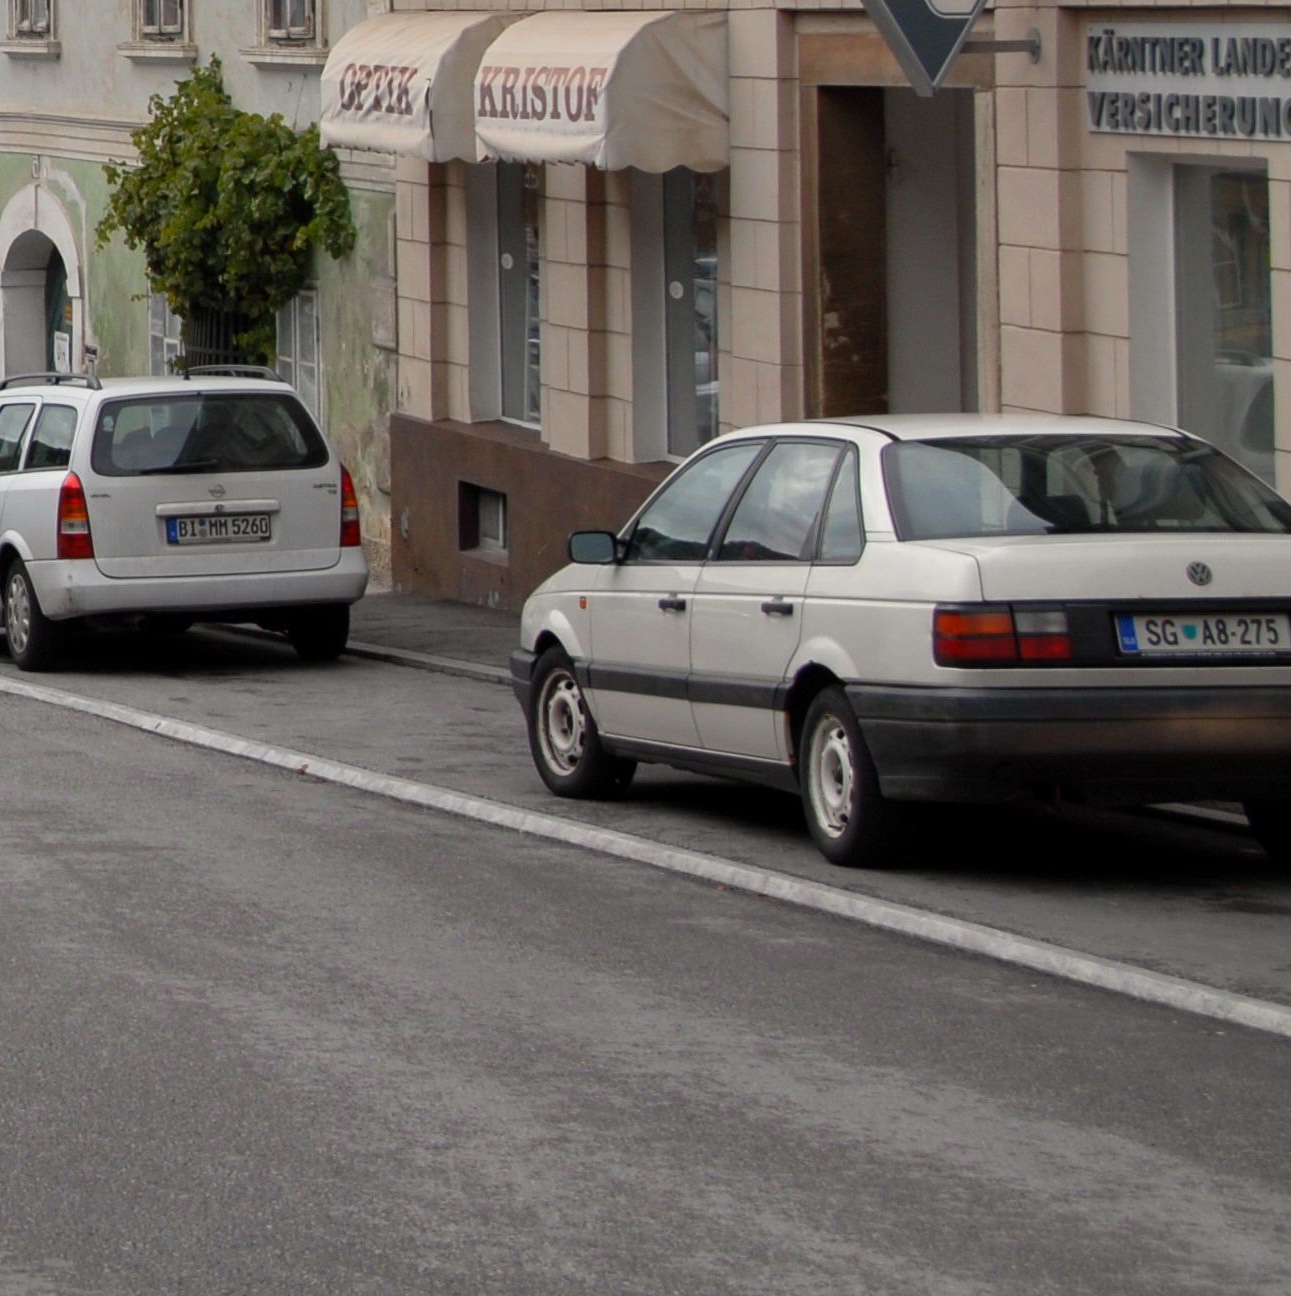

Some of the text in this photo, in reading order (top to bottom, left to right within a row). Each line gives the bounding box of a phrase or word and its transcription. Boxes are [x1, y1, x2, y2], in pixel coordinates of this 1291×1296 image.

[1087, 29, 1205, 76] KÄRNTNER
[339, 63, 608, 122] OPTIK KRISTOF
[178, 517, 269, 538] BI MM 5260
[1145, 618, 1280, 646] SG A8-275
